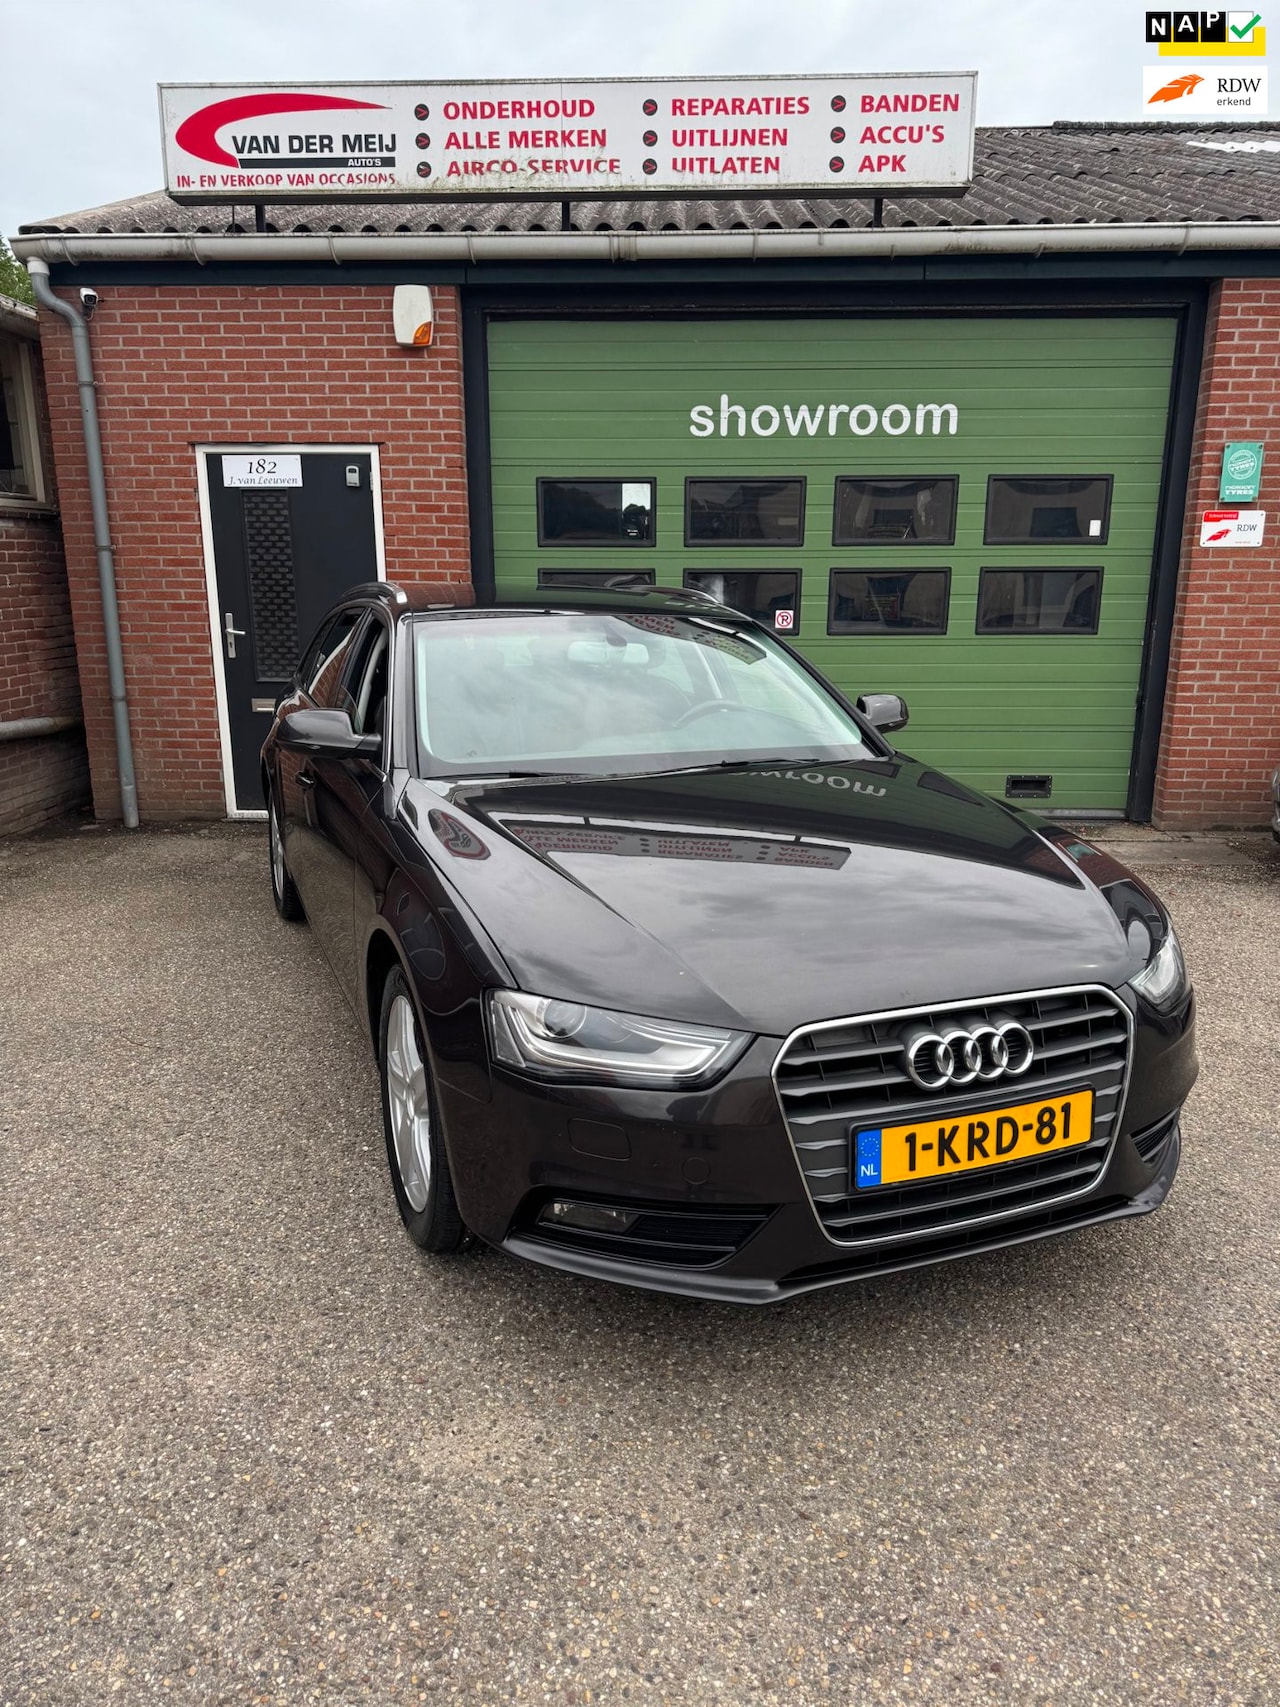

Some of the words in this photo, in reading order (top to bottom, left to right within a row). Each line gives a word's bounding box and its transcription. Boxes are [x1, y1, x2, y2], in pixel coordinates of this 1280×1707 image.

[443, 99, 595, 120] ONDERHOUD
[671, 96, 810, 117] REPARATIES
[860, 93, 960, 114] BANDEN
[231, 135, 280, 154] VAN
[288, 134, 334, 154] DER
[342, 133, 397, 153] MEIJ
[444, 131, 501, 150] ALLE
[508, 128, 607, 149] MERKEN
[671, 127, 788, 147] UITLIJNEN
[859, 125, 945, 144] ACCU'S
[347, 158, 382, 167] AUTO'S
[671, 155, 781, 174] UITLATEN
[858, 154, 907, 174] APK
[177, 175, 196, 188] IN-
[200, 175, 217, 188] EN
[221, 174, 283, 187] VERKOOP
[287, 173, 315, 187] VAN
[318, 173, 397, 187] OCCASIONS
[689, 394, 959, 437] showroom
[247, 458, 277, 474] 182
[238, 477, 256, 485] van
[257, 475, 298, 485] Leeuwen
[1236, 524, 1258, 532] RDW
[904, 1101, 1072, 1172] 1-KRD-81
[860, 1163, 879, 1177] NL
